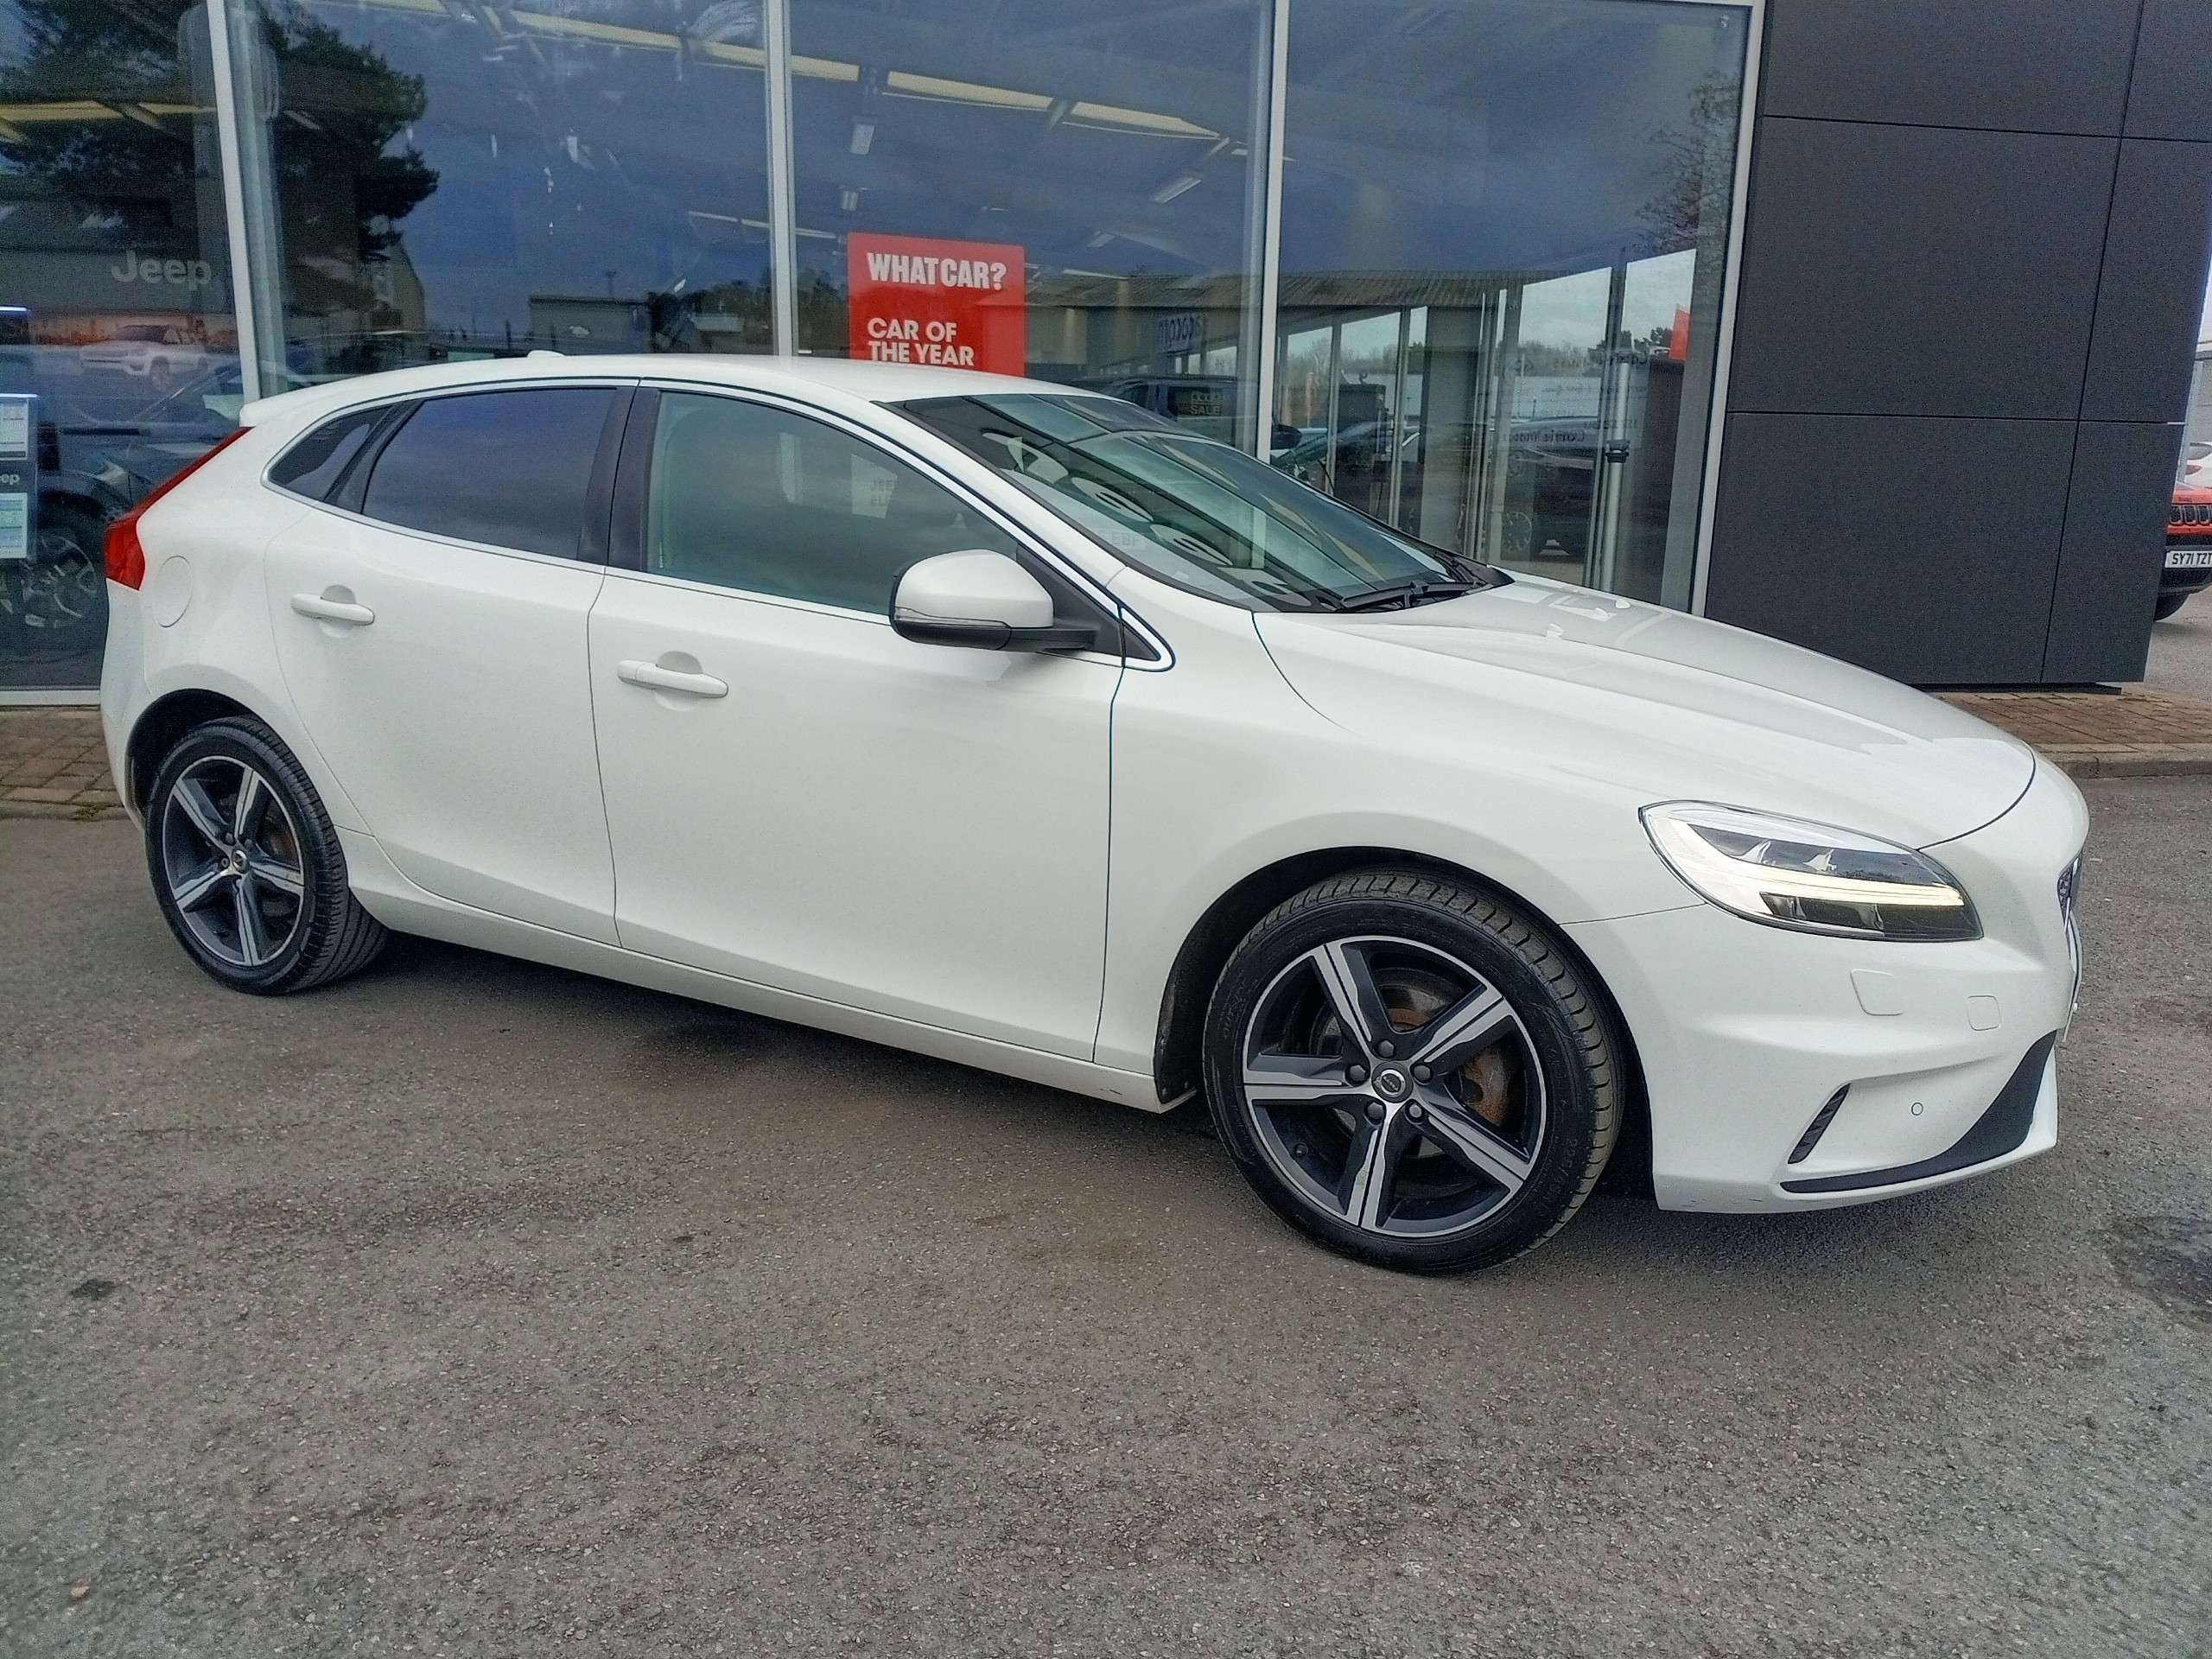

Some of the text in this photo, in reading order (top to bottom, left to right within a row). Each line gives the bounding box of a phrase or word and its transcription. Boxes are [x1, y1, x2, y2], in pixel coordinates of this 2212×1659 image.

[111, 249, 212, 291] Jeep
[867, 317, 957, 343] CAR OF
[868, 340, 975, 366] THE YEAR
[2171, 552, 2195, 565] SY71
